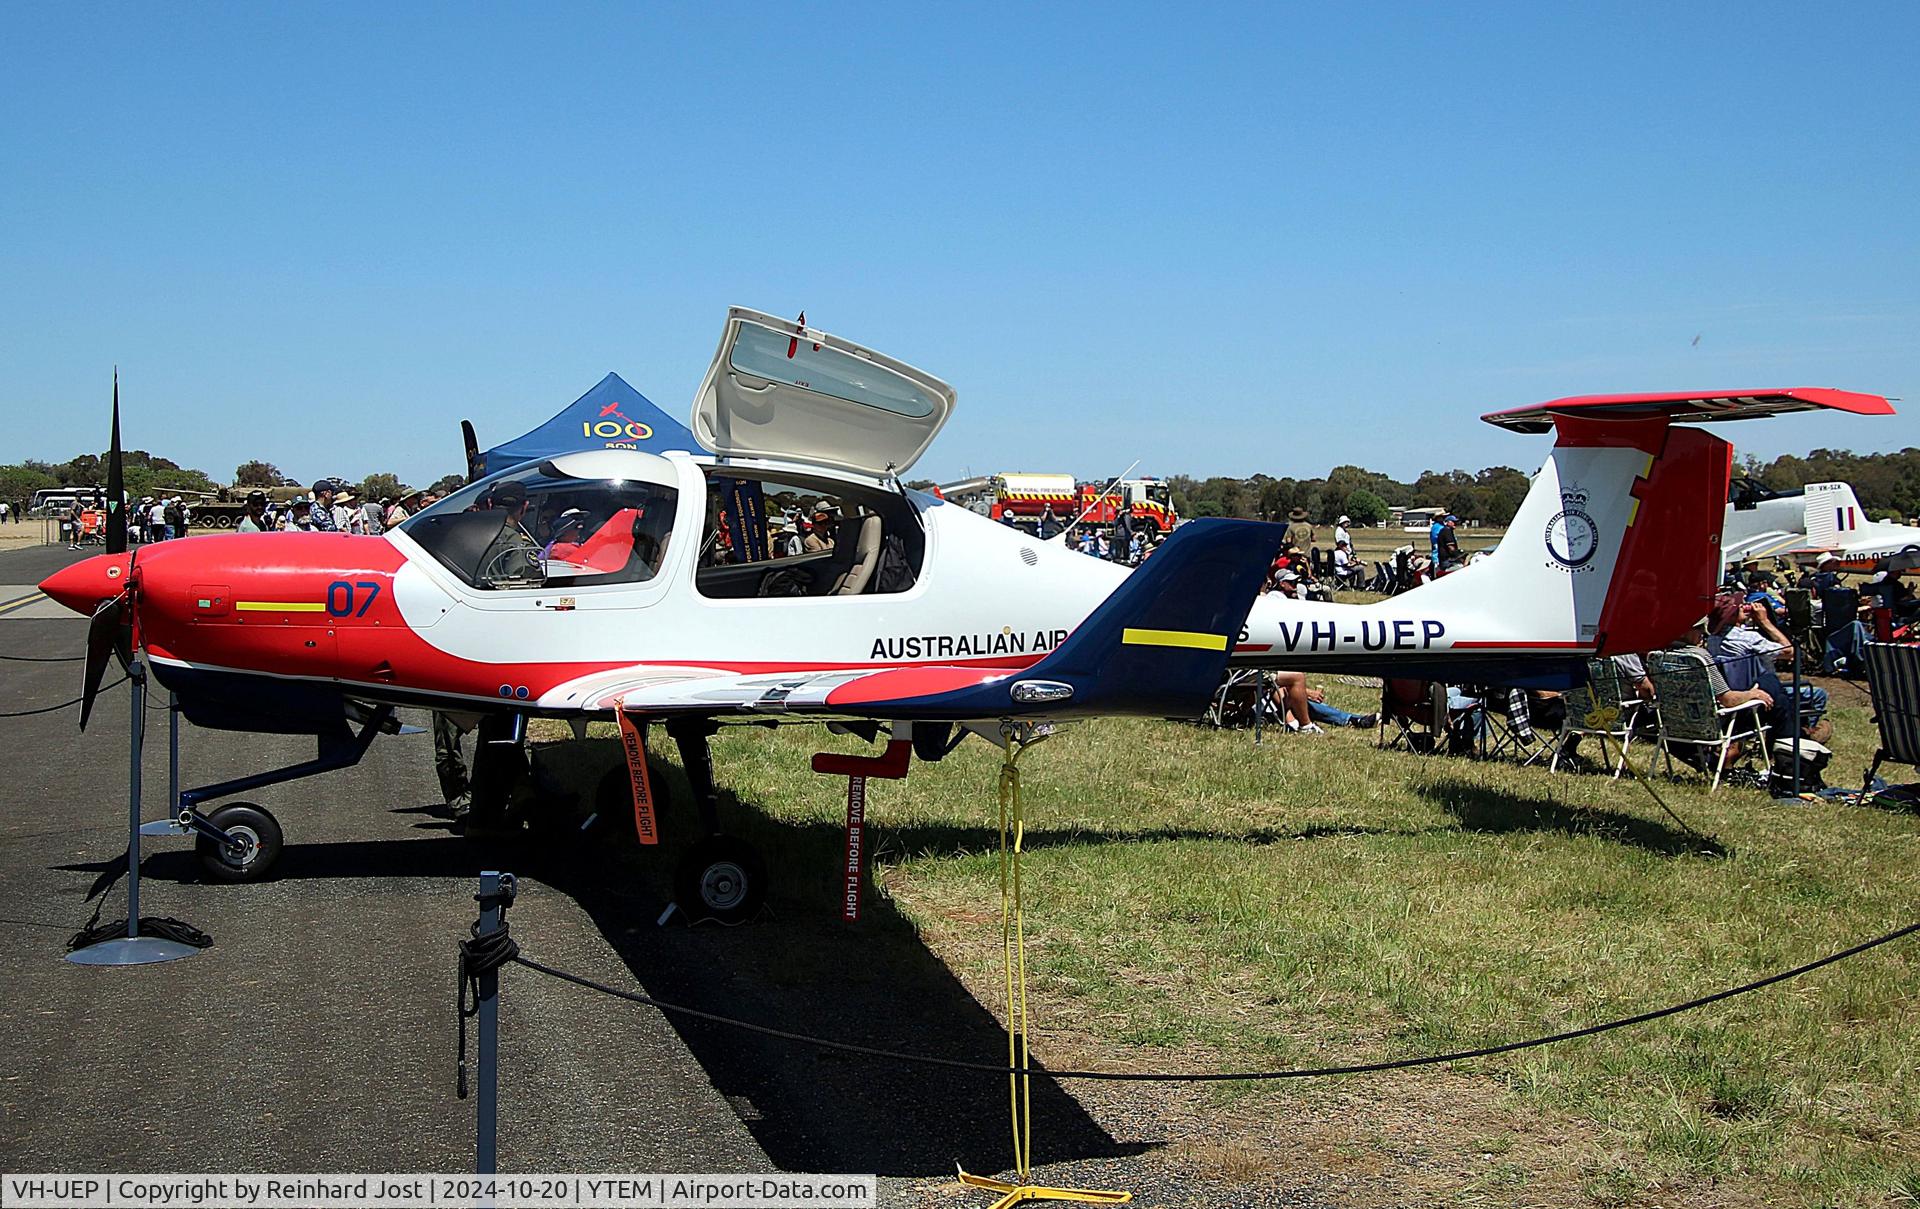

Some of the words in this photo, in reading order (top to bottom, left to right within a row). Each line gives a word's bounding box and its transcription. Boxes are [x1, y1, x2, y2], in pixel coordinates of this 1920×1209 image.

[328, 582, 381, 617] 07
[870, 633, 1025, 659] AUSTRALIAN
[1279, 620, 1445, 652] VH-UEP
[625, 731, 640, 768] REMOVE
[632, 769, 648, 804] BEFORE
[850, 776, 862, 823] REMOVE
[640, 805, 653, 838] FLIGHT
[848, 827, 860, 873] BEFORE
[846, 876, 858, 918] FLIGHT
